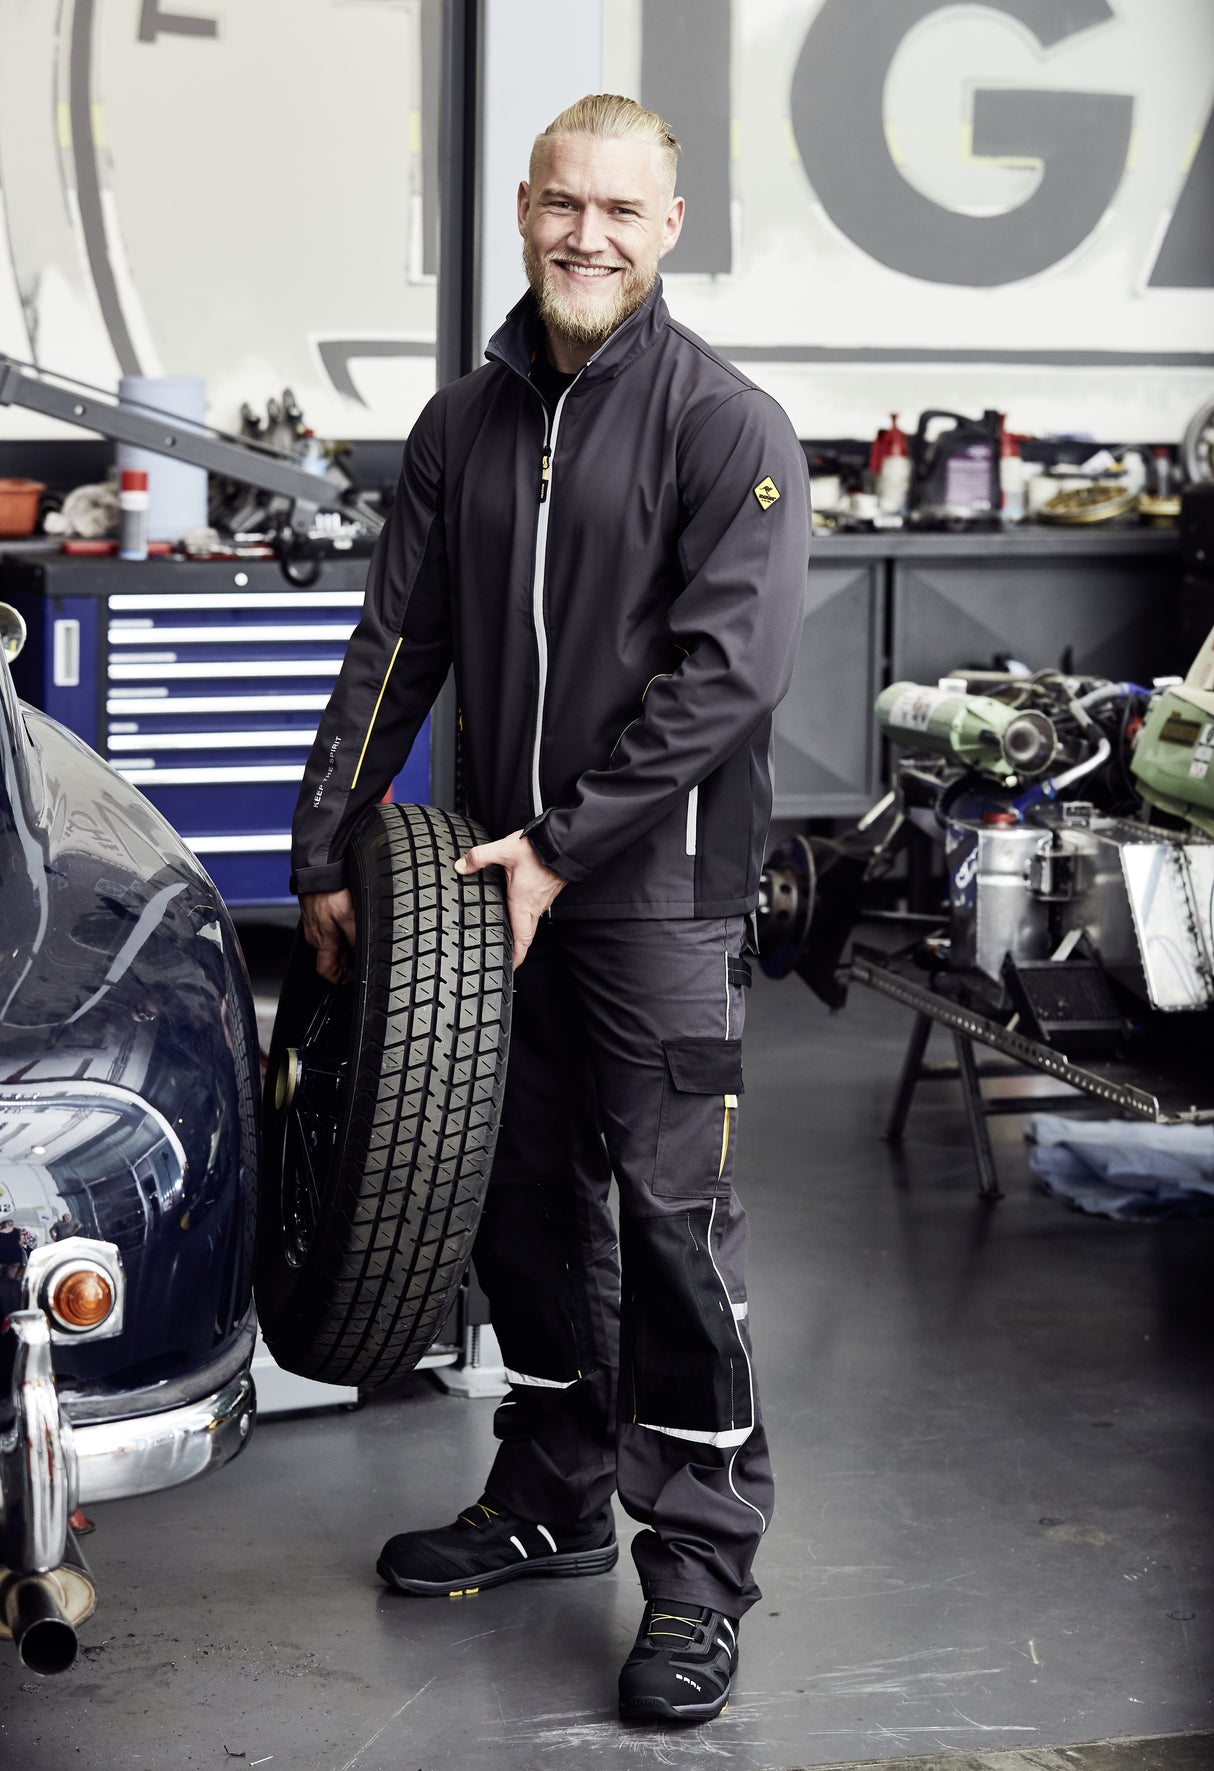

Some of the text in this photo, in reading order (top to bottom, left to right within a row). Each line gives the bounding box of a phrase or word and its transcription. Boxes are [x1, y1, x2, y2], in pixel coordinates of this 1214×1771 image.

[313, 736, 342, 808] KEEP THE SPIRIT
